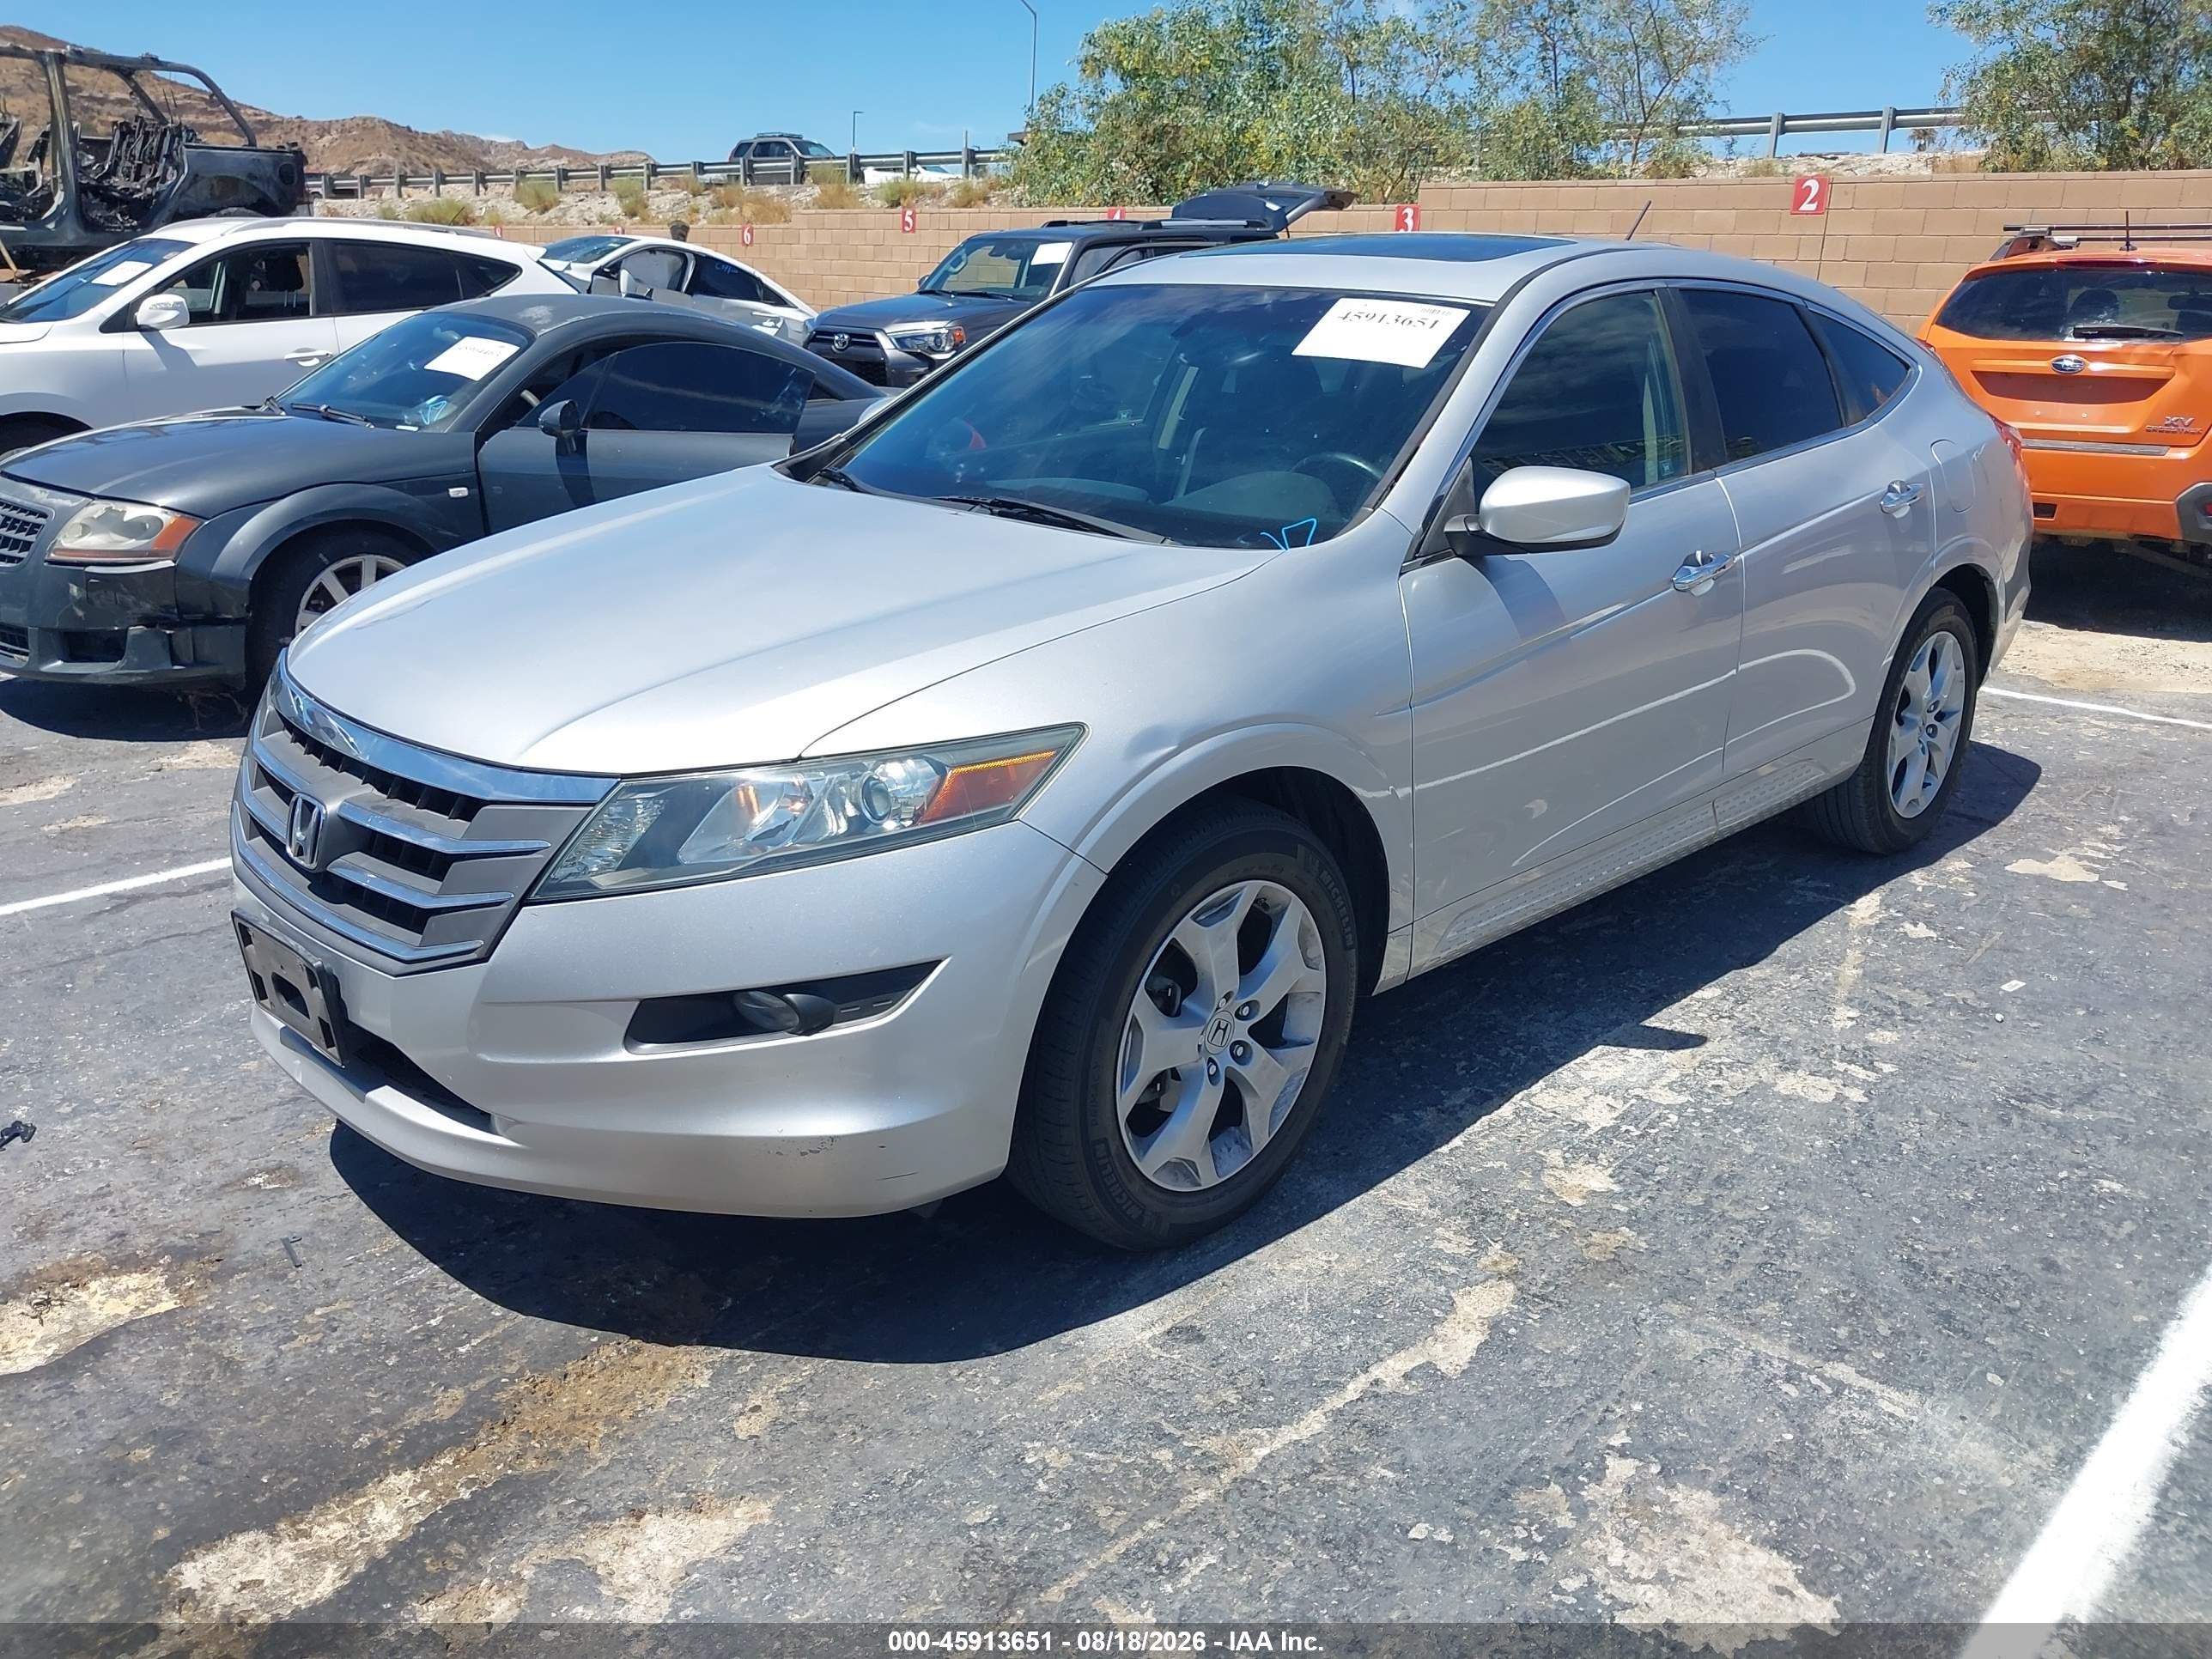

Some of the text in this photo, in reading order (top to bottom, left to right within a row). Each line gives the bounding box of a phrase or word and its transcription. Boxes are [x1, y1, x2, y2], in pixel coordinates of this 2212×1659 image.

[1798, 179, 1820, 211] 2
[904, 210, 914, 232] 5
[1401, 207, 1415, 233] 3
[743, 226, 751, 245] 6
[1338, 310, 1439, 329] 45913651
[1317, 869, 1356, 947] MICHELIN
